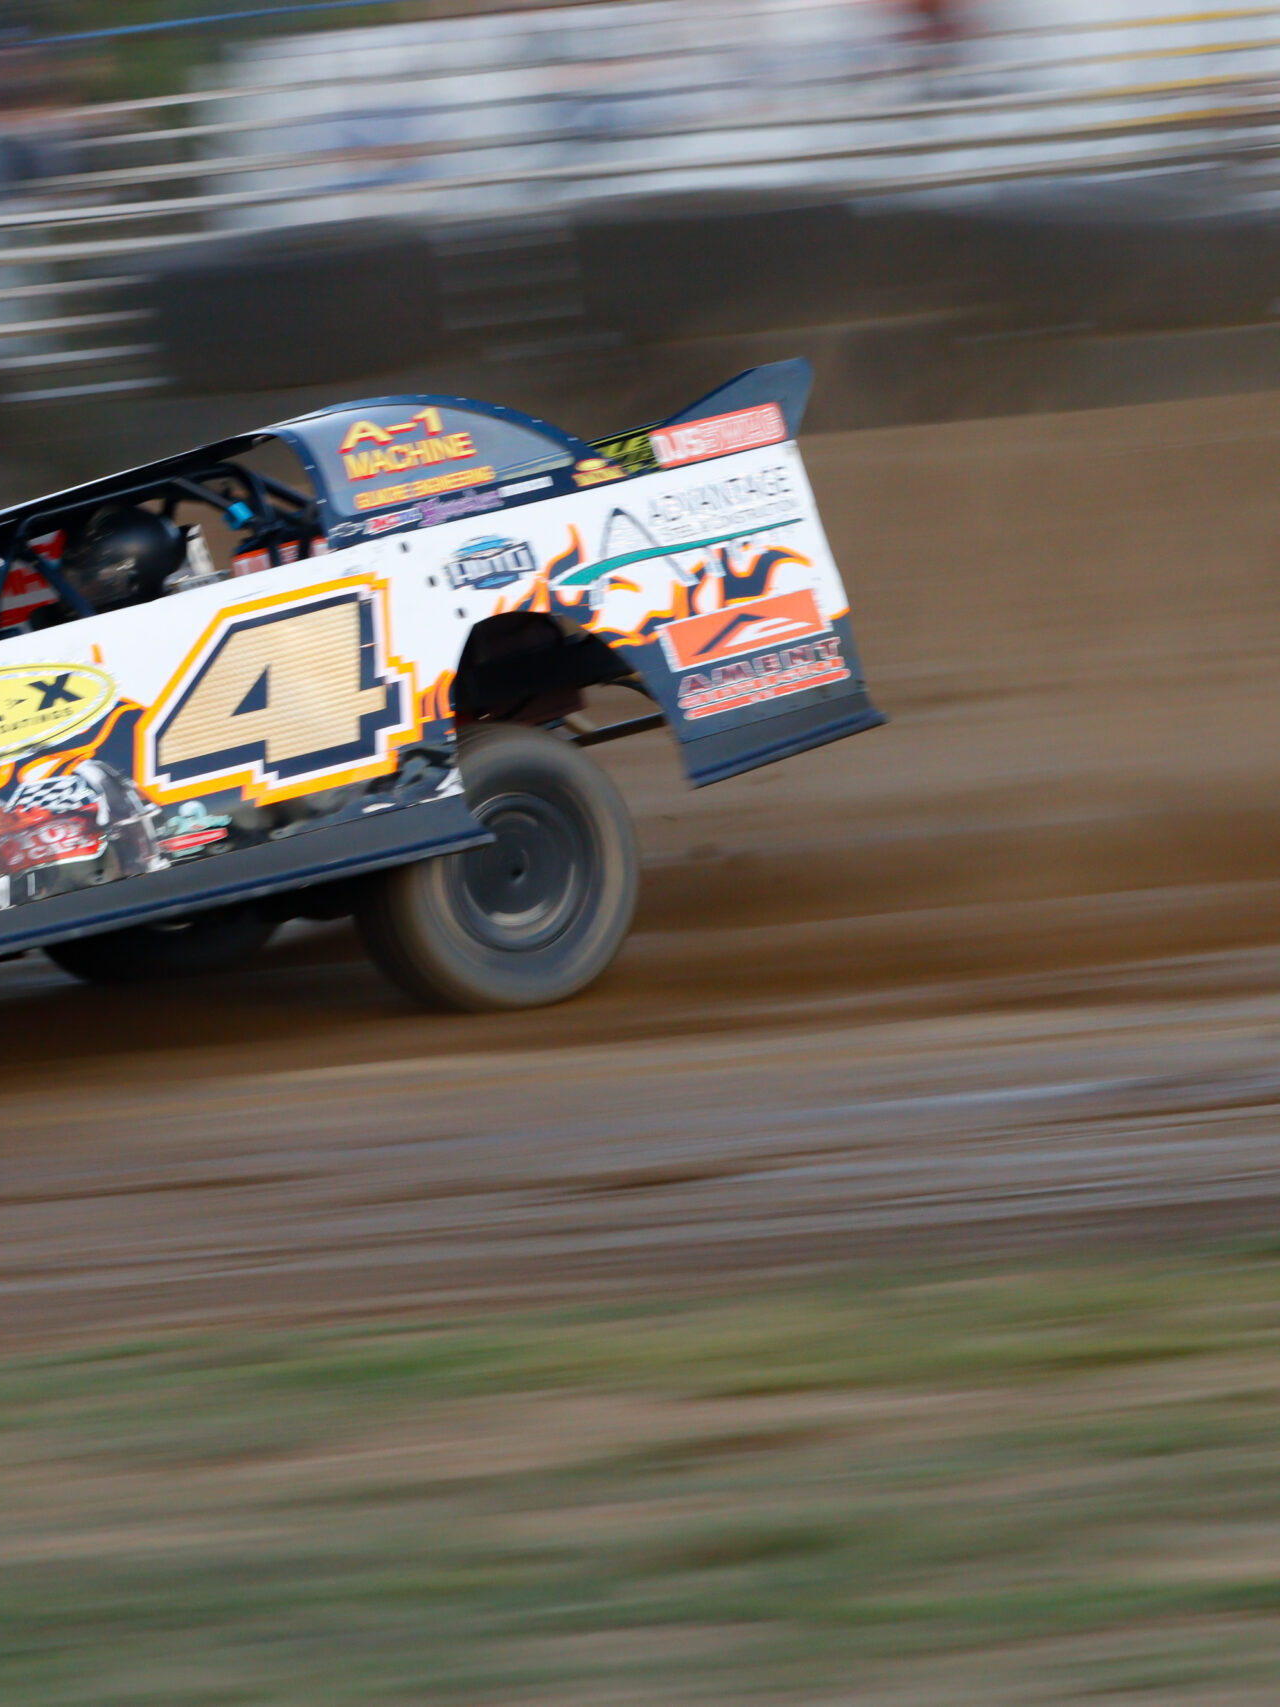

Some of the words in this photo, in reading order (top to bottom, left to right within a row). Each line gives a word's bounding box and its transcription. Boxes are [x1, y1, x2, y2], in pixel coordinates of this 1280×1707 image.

[338, 407, 444, 454] A-1
[342, 432, 478, 482] MACHINE
[152, 589, 402, 784] 4
